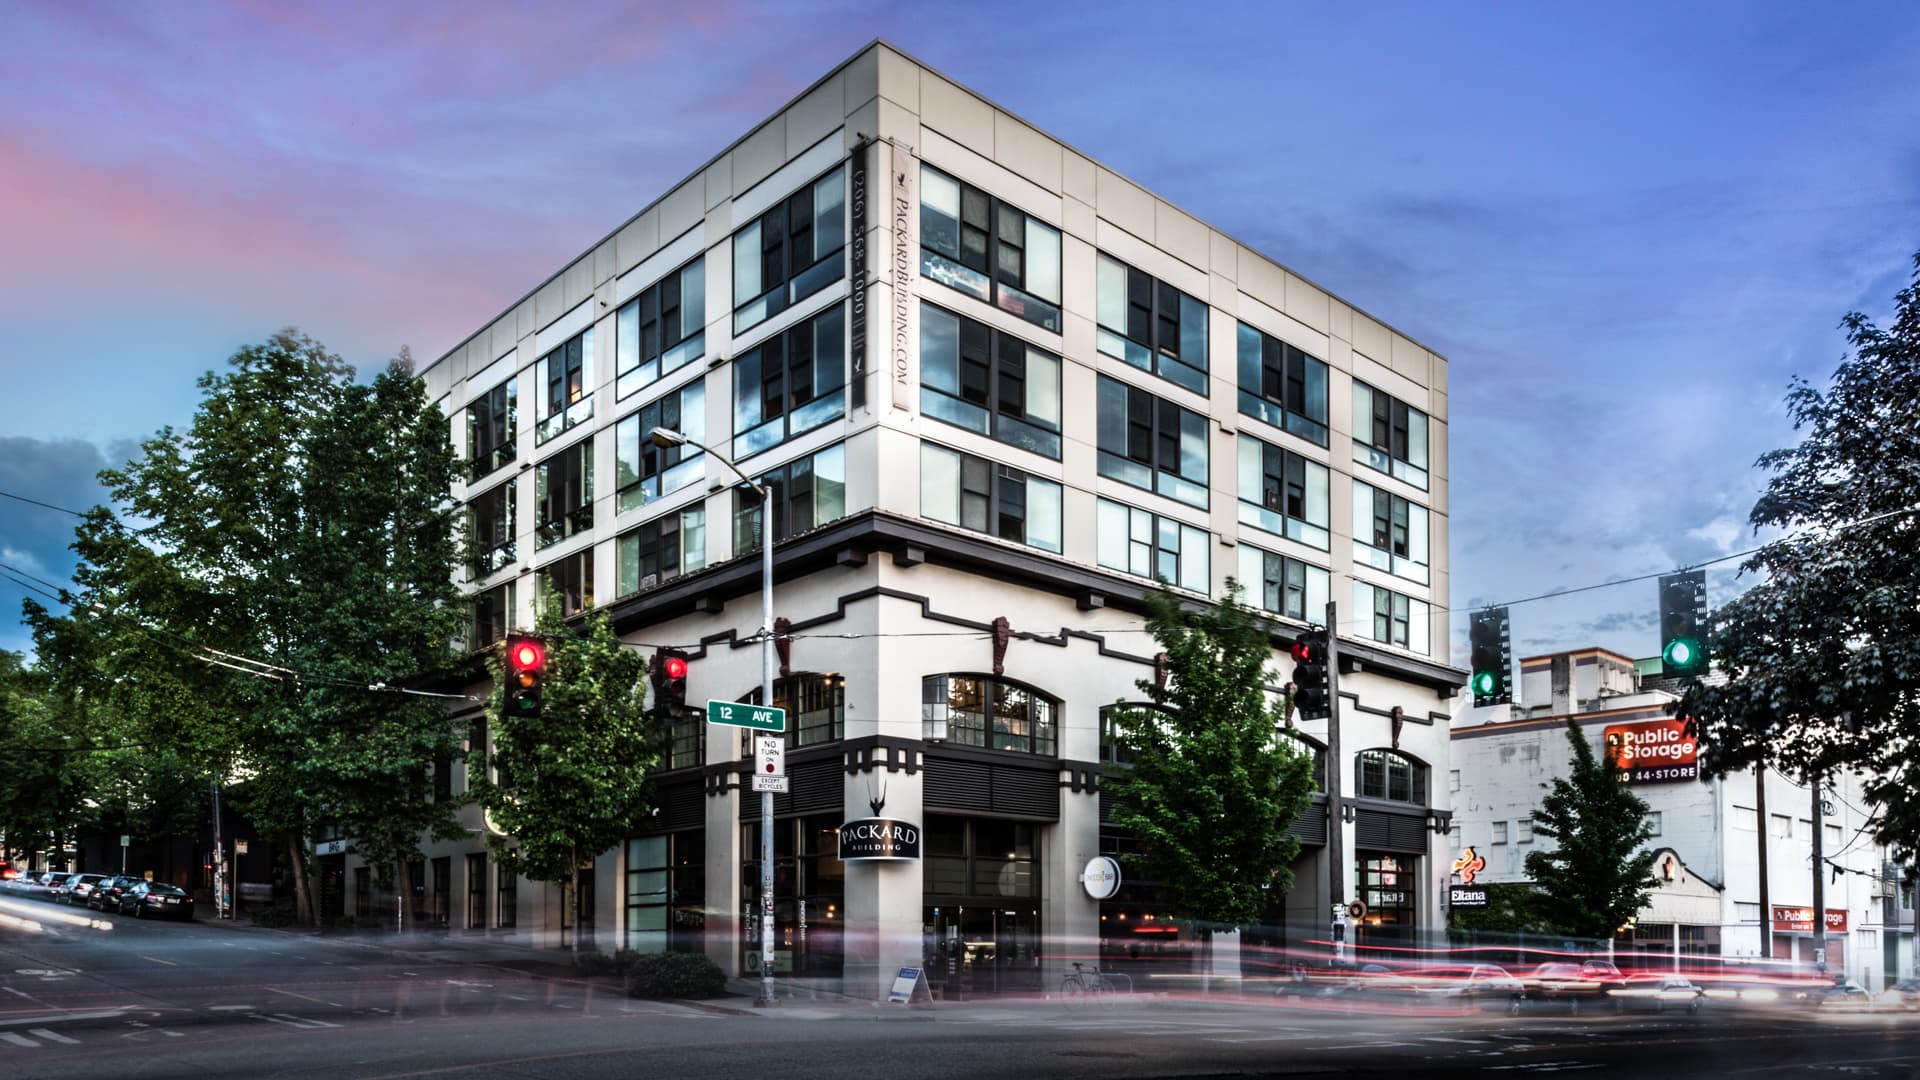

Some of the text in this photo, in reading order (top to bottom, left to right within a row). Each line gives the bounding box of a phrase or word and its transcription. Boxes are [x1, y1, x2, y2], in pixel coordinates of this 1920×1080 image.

[853, 169, 866, 314] (206) 568-1000
[896, 197, 909, 385] PACKARDBUILDING.COM
[720, 706, 773, 723] 12 AVE
[764, 740, 776, 748] NO
[1623, 728, 1679, 746] Public
[1623, 743, 1694, 760] Storage
[842, 825, 917, 845] PACKARD
[1451, 890, 1486, 901] Eltana
